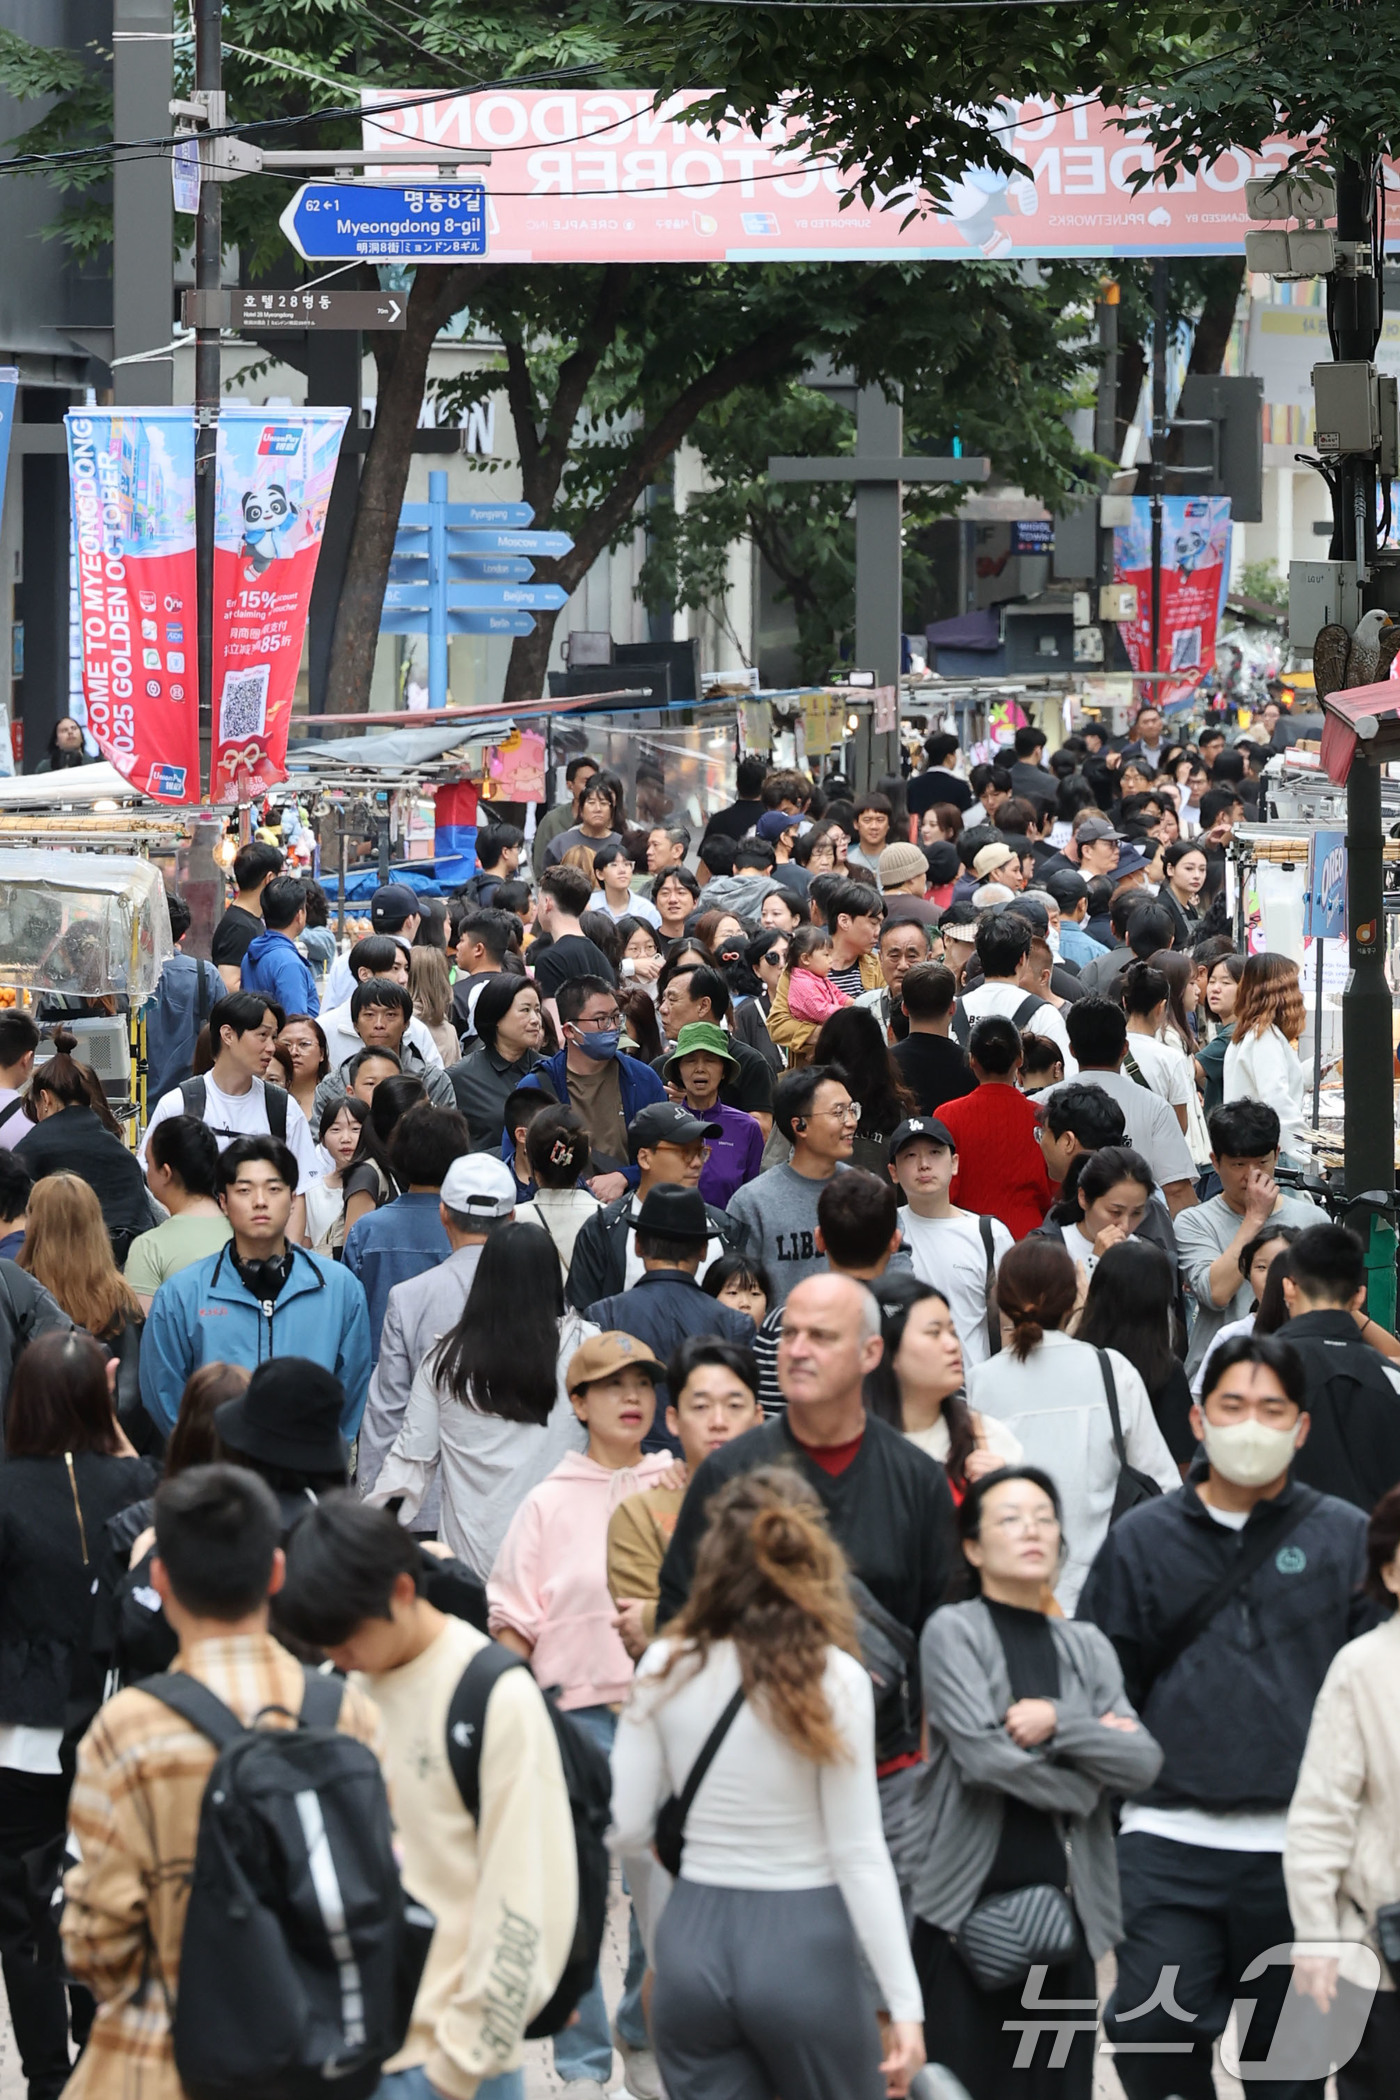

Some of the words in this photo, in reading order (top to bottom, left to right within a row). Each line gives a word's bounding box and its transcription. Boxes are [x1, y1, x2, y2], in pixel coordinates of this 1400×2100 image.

[305, 200, 320, 212] 62
[334, 200, 340, 212] 1
[404, 188, 481, 213] 명동8길
[336, 219, 440, 236] Myeongdong
[444, 217, 481, 235] 8-gil
[356, 241, 399, 254] 明洞8街
[404, 241, 480, 254] ミョンドン8ギル
[264, 311, 295, 319] Myeongdong
[262, 433, 300, 445] UnionPay
[72, 418, 105, 612] MYEONGDONG
[97, 451, 127, 581] OCTOBER
[470, 508, 508, 520] Pyongyang
[498, 537, 538, 548] Moscow
[483, 563, 509, 574] London
[239, 590, 277, 609] 15%
[503, 590, 535, 603] Beijing
[233, 609, 266, 620] claiming
[490, 617, 510, 629] Berlin
[85, 616, 107, 655] TO
[106, 586, 133, 698] GOLDEN
[112, 703, 135, 753] 025
[1321, 846, 1344, 908] OREO
[776, 1231, 825, 1261] LIB
